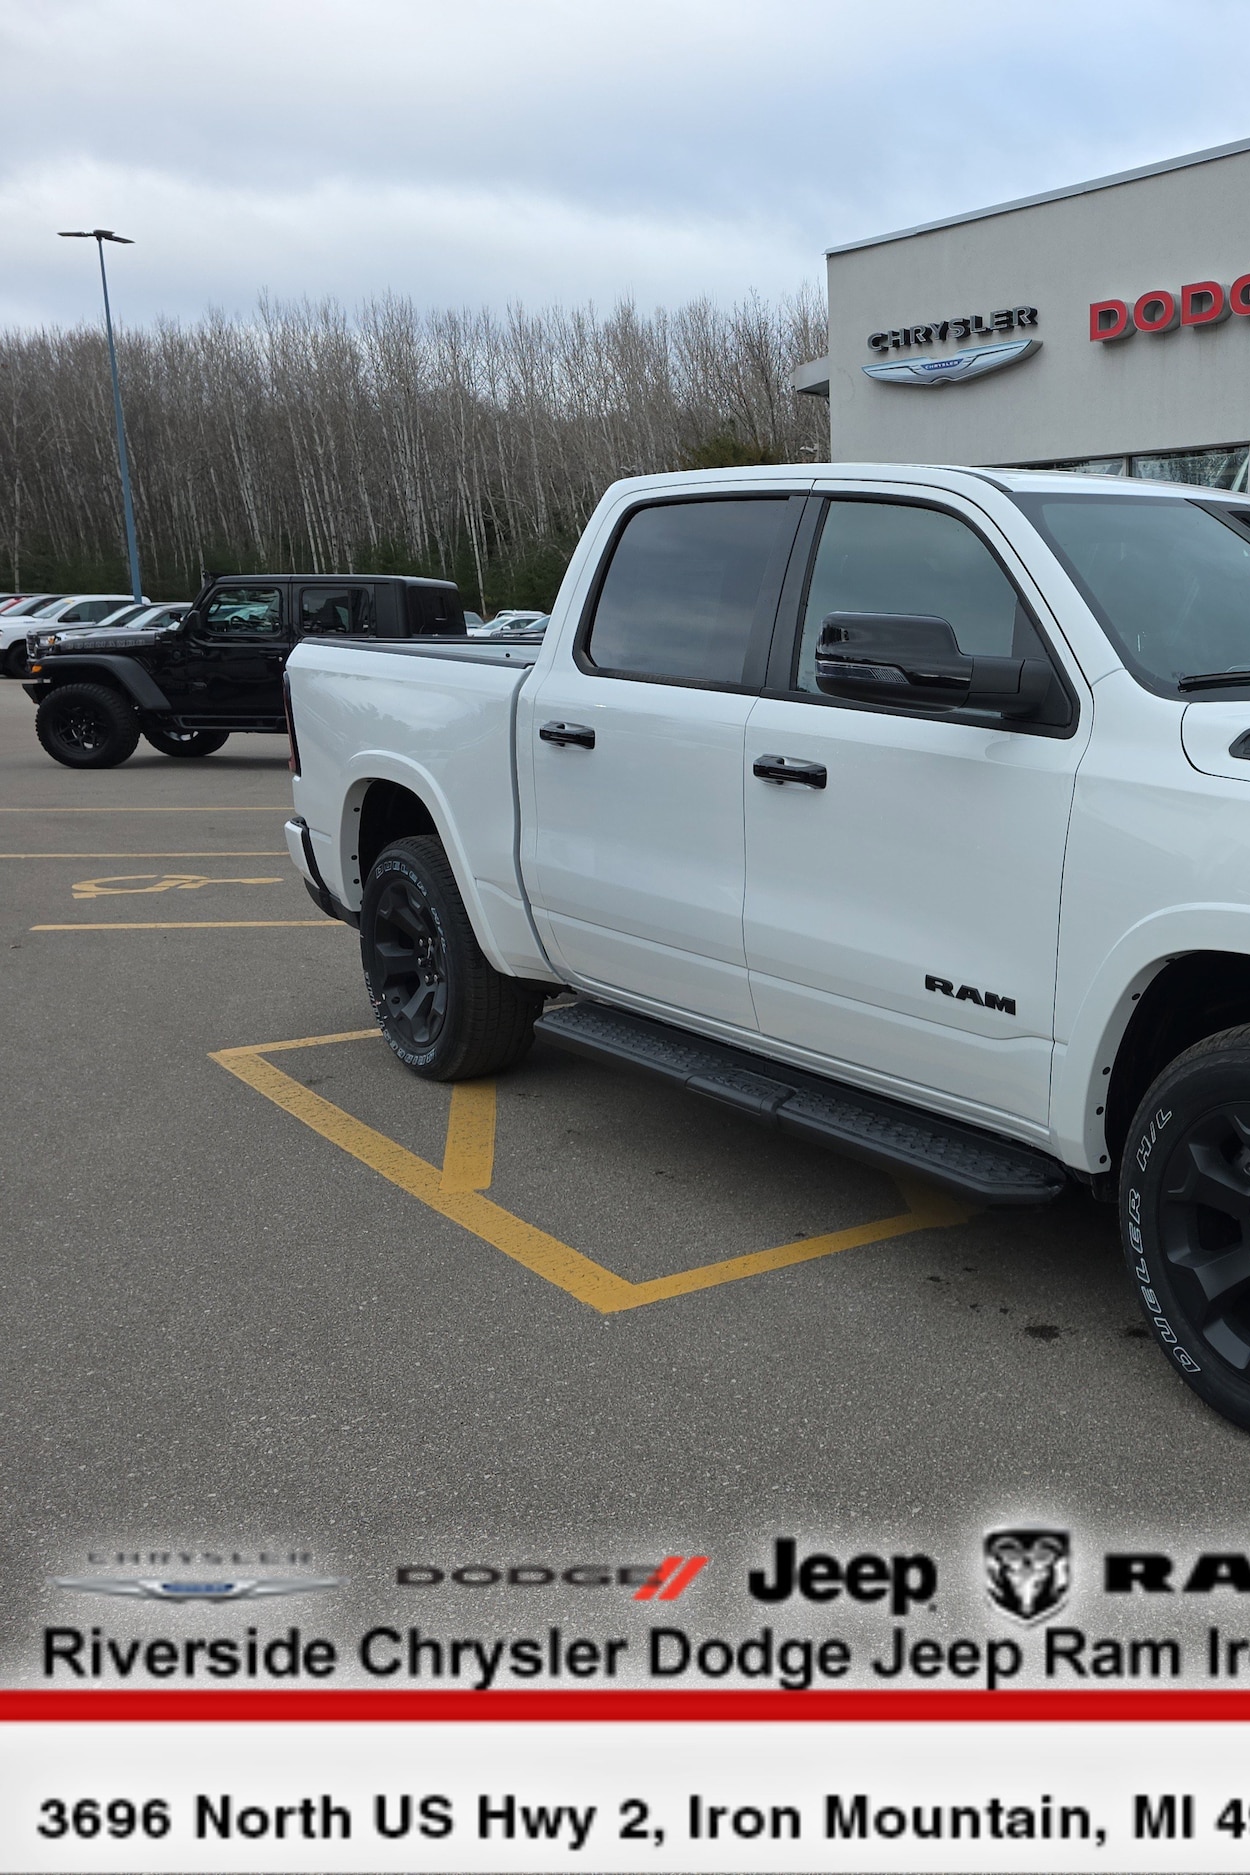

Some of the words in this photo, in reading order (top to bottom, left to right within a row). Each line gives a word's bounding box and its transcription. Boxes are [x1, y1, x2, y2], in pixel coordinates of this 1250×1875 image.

[867, 305, 1038, 352] CHRYSLER
[925, 974, 1016, 1016] RAM
[1128, 1187, 1201, 1374] DUELER
